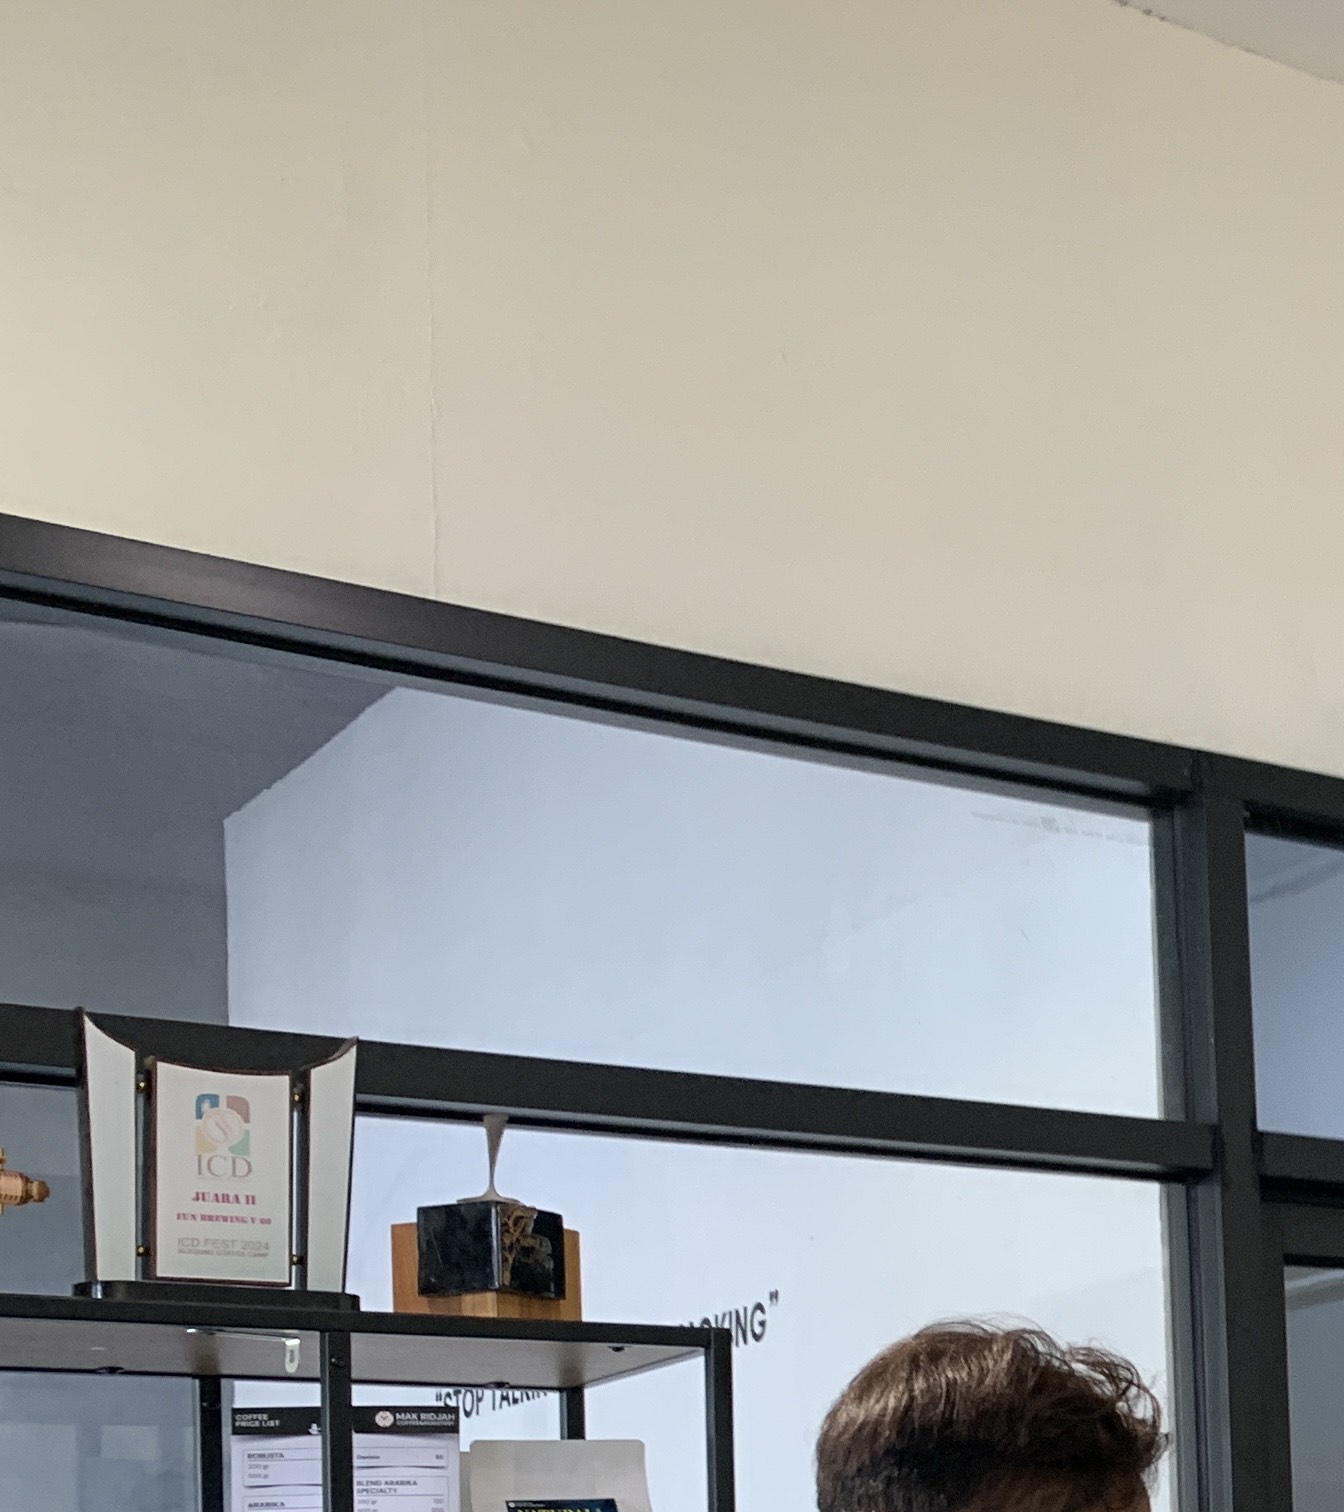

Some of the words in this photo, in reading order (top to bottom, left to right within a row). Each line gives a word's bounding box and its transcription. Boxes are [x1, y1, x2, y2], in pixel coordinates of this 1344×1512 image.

[197, 1154, 253, 1178] ICD
[192, 1191, 241, 1205] JUARA
[235, 1413, 268, 1421] COFFEE
[396, 1412, 418, 1420] MAK
[420, 1412, 455, 1421] RIDJAH
[262, 1419, 280, 1427] LIST
